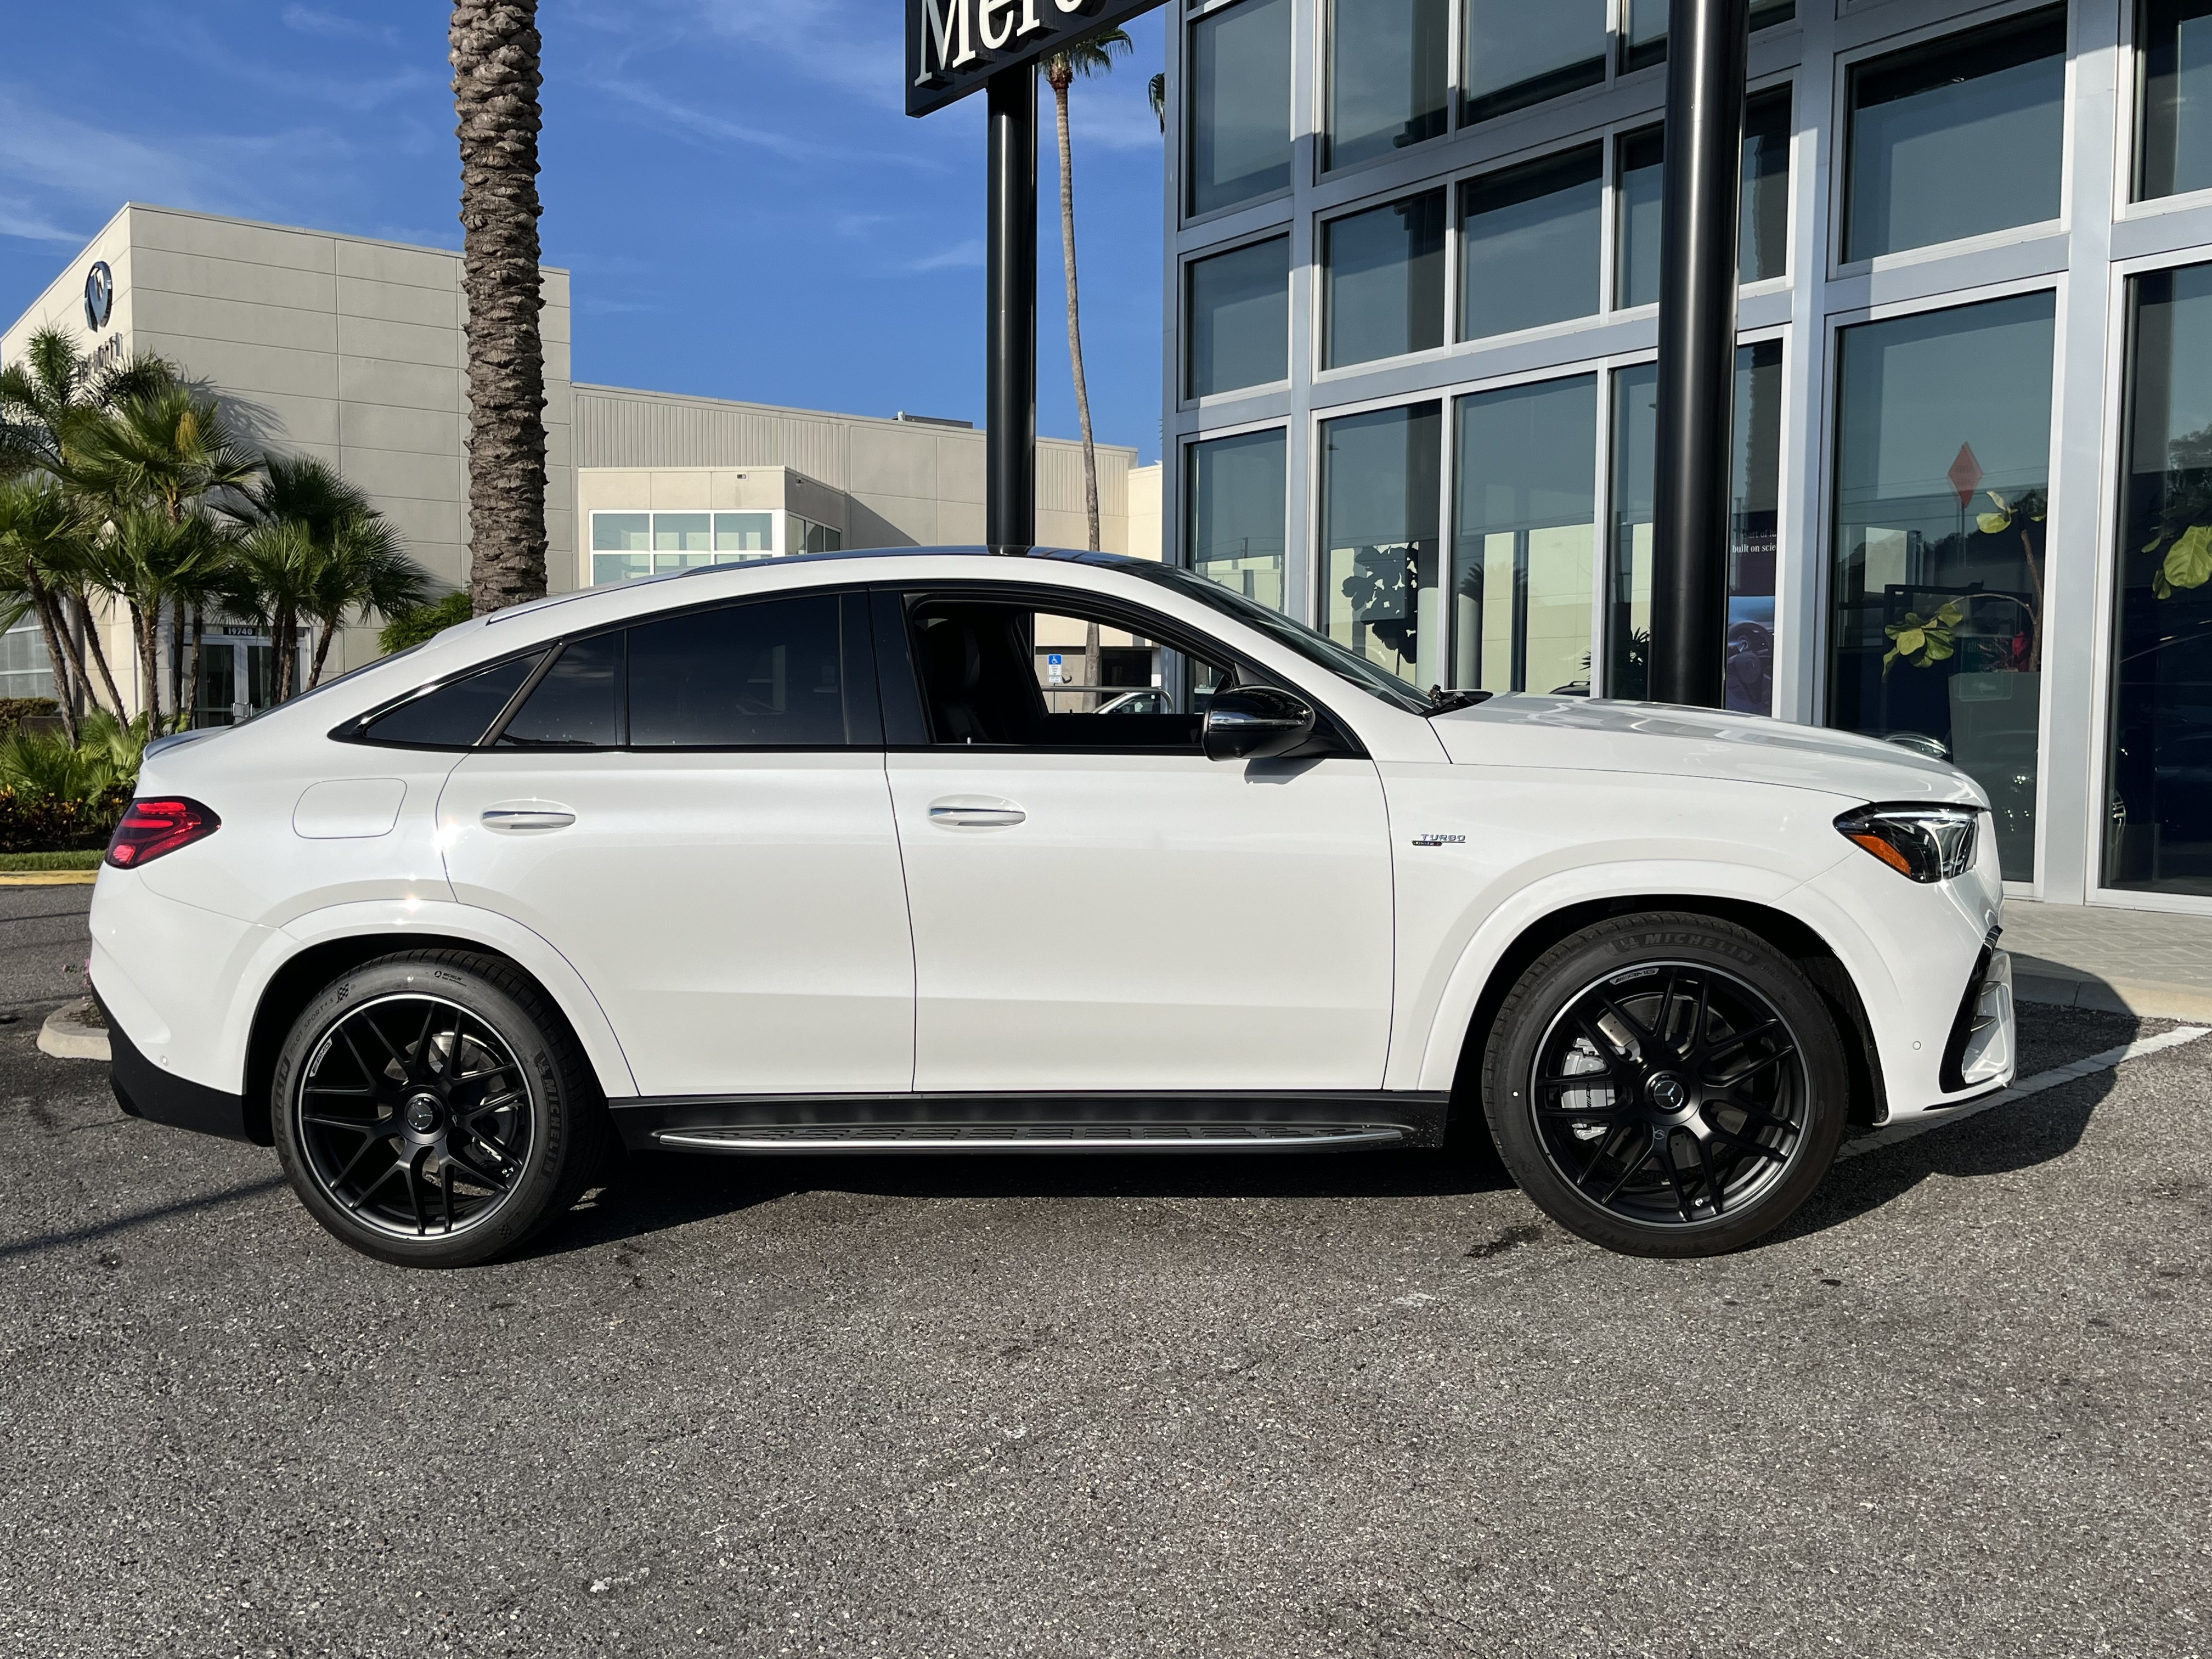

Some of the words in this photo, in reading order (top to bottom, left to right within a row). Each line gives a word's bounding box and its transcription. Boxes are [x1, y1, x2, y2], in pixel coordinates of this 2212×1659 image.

[1732, 544, 1748, 553] built
[1644, 933, 1754, 962] MICHELIN
[1628, 969, 1656, 978] AMG
[289, 1030, 303, 1054] PILOT
[303, 1005, 325, 1029] SPORT
[318, 1042, 331, 1064] AMG
[543, 1078, 561, 1173] MICHELIN
